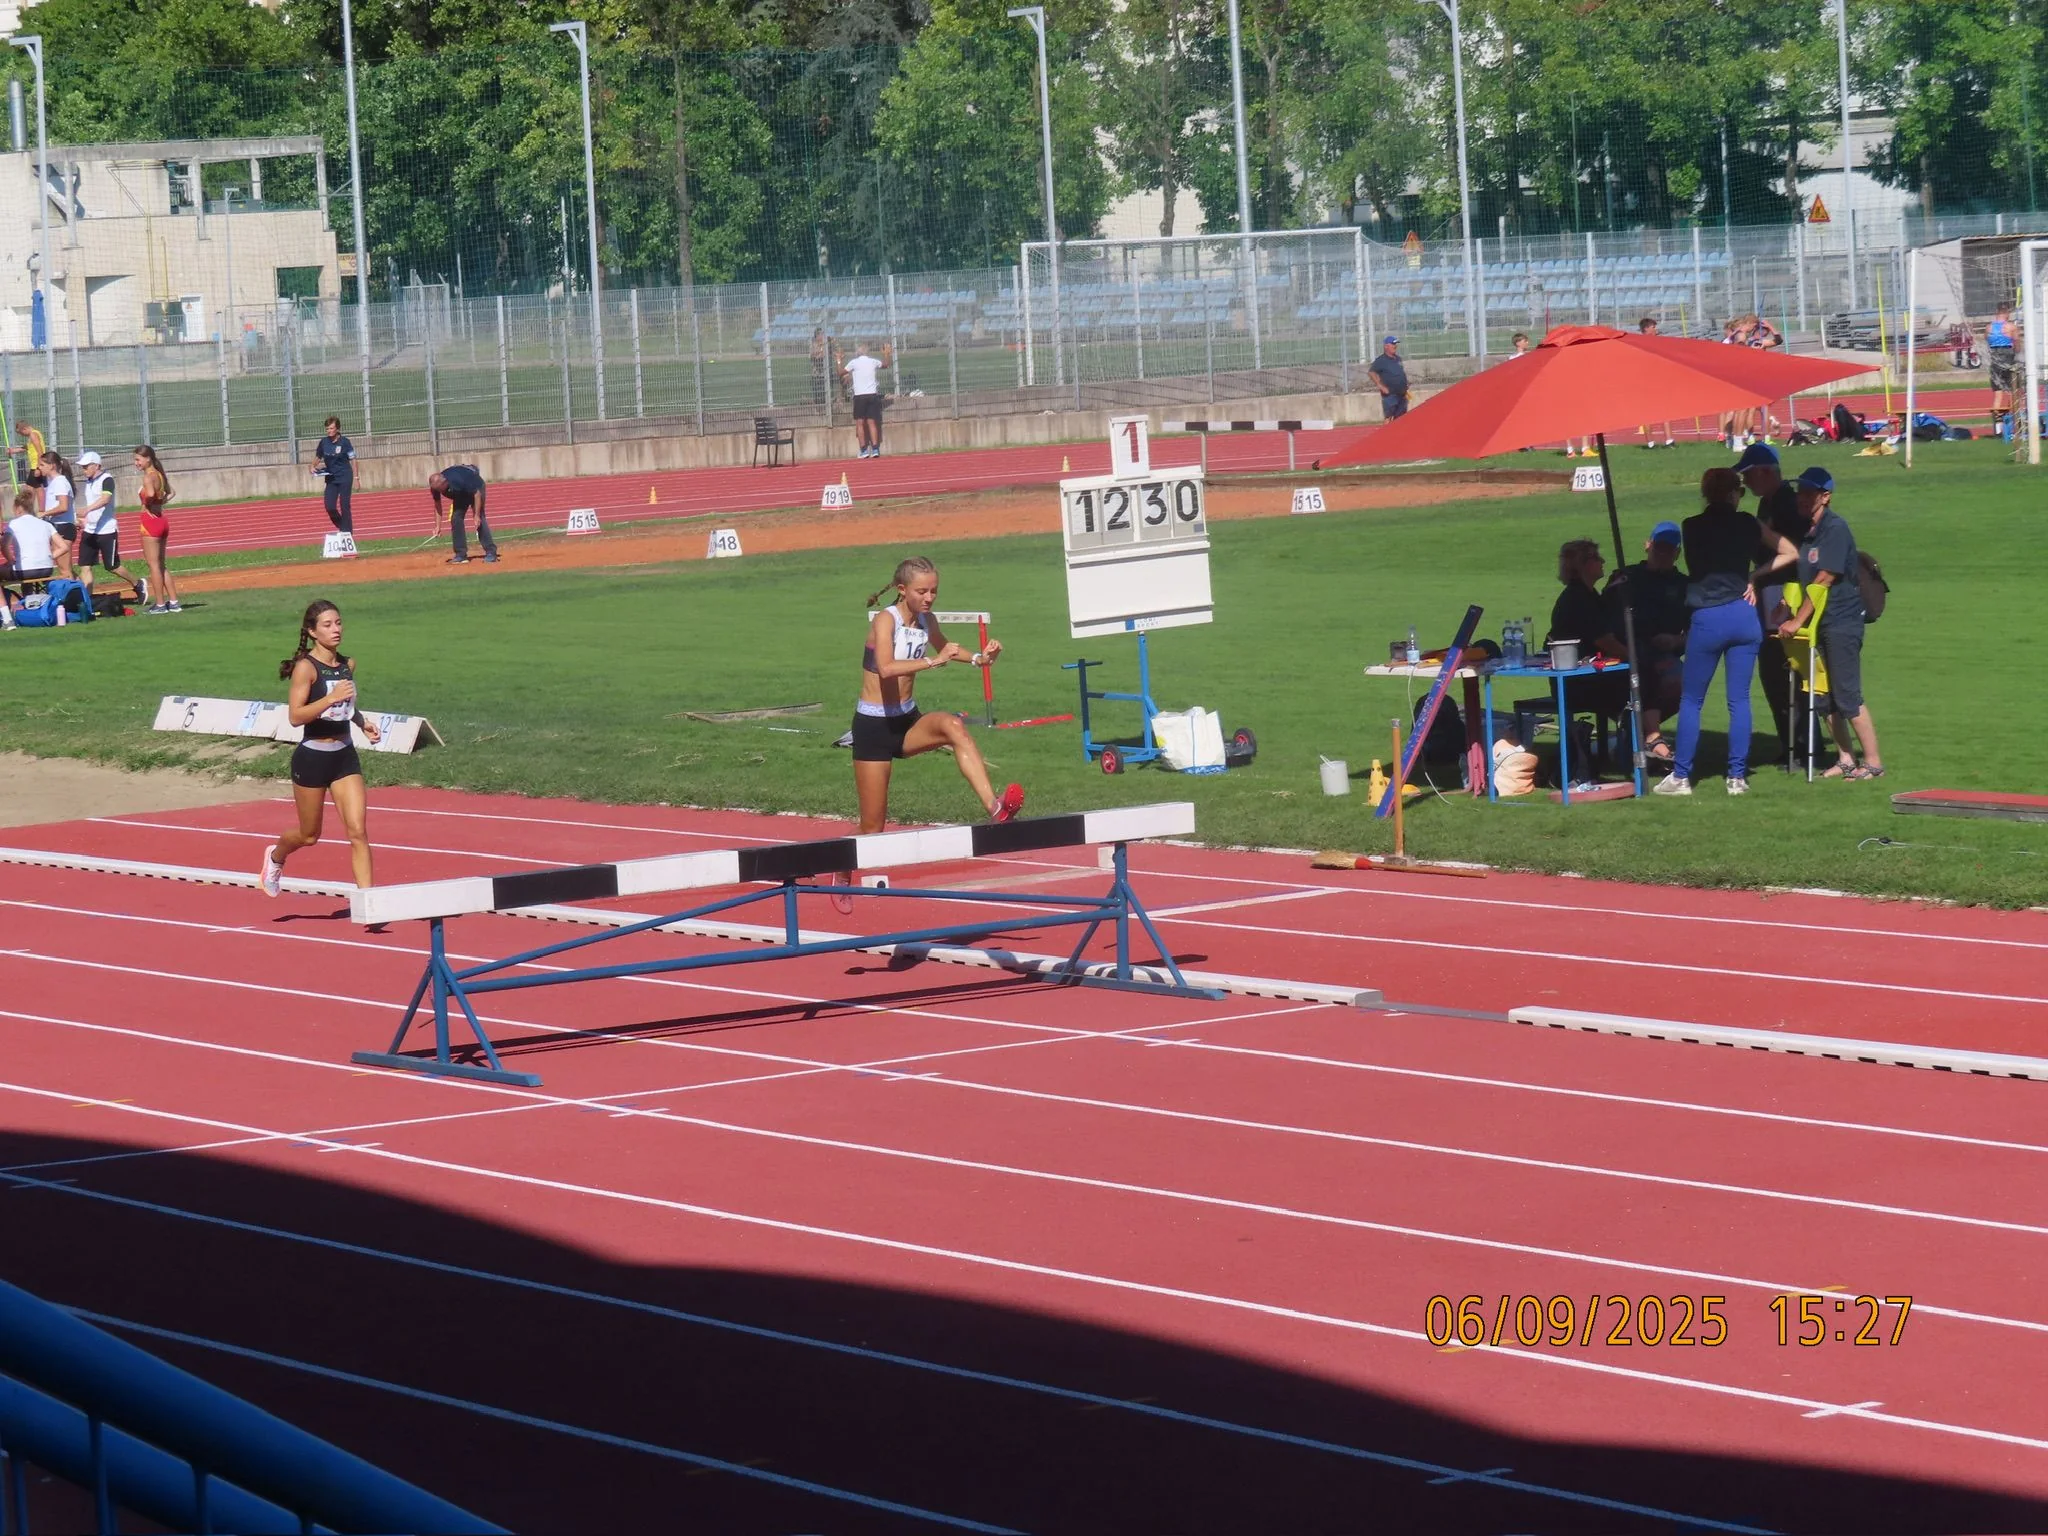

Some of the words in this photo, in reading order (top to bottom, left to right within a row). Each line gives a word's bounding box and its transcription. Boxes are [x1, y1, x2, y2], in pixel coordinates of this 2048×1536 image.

[1122, 422, 1140, 463] 1
[1575, 473, 1587, 488] 19
[1589, 473, 1603, 487] 19
[825, 490, 837, 505] 19
[839, 490, 850, 504] 19
[1294, 495, 1304, 510] 15
[1305, 494, 1322, 509] 15
[571, 515, 584, 529] 15
[585, 514, 597, 528] 15
[719, 536, 737, 550] 18
